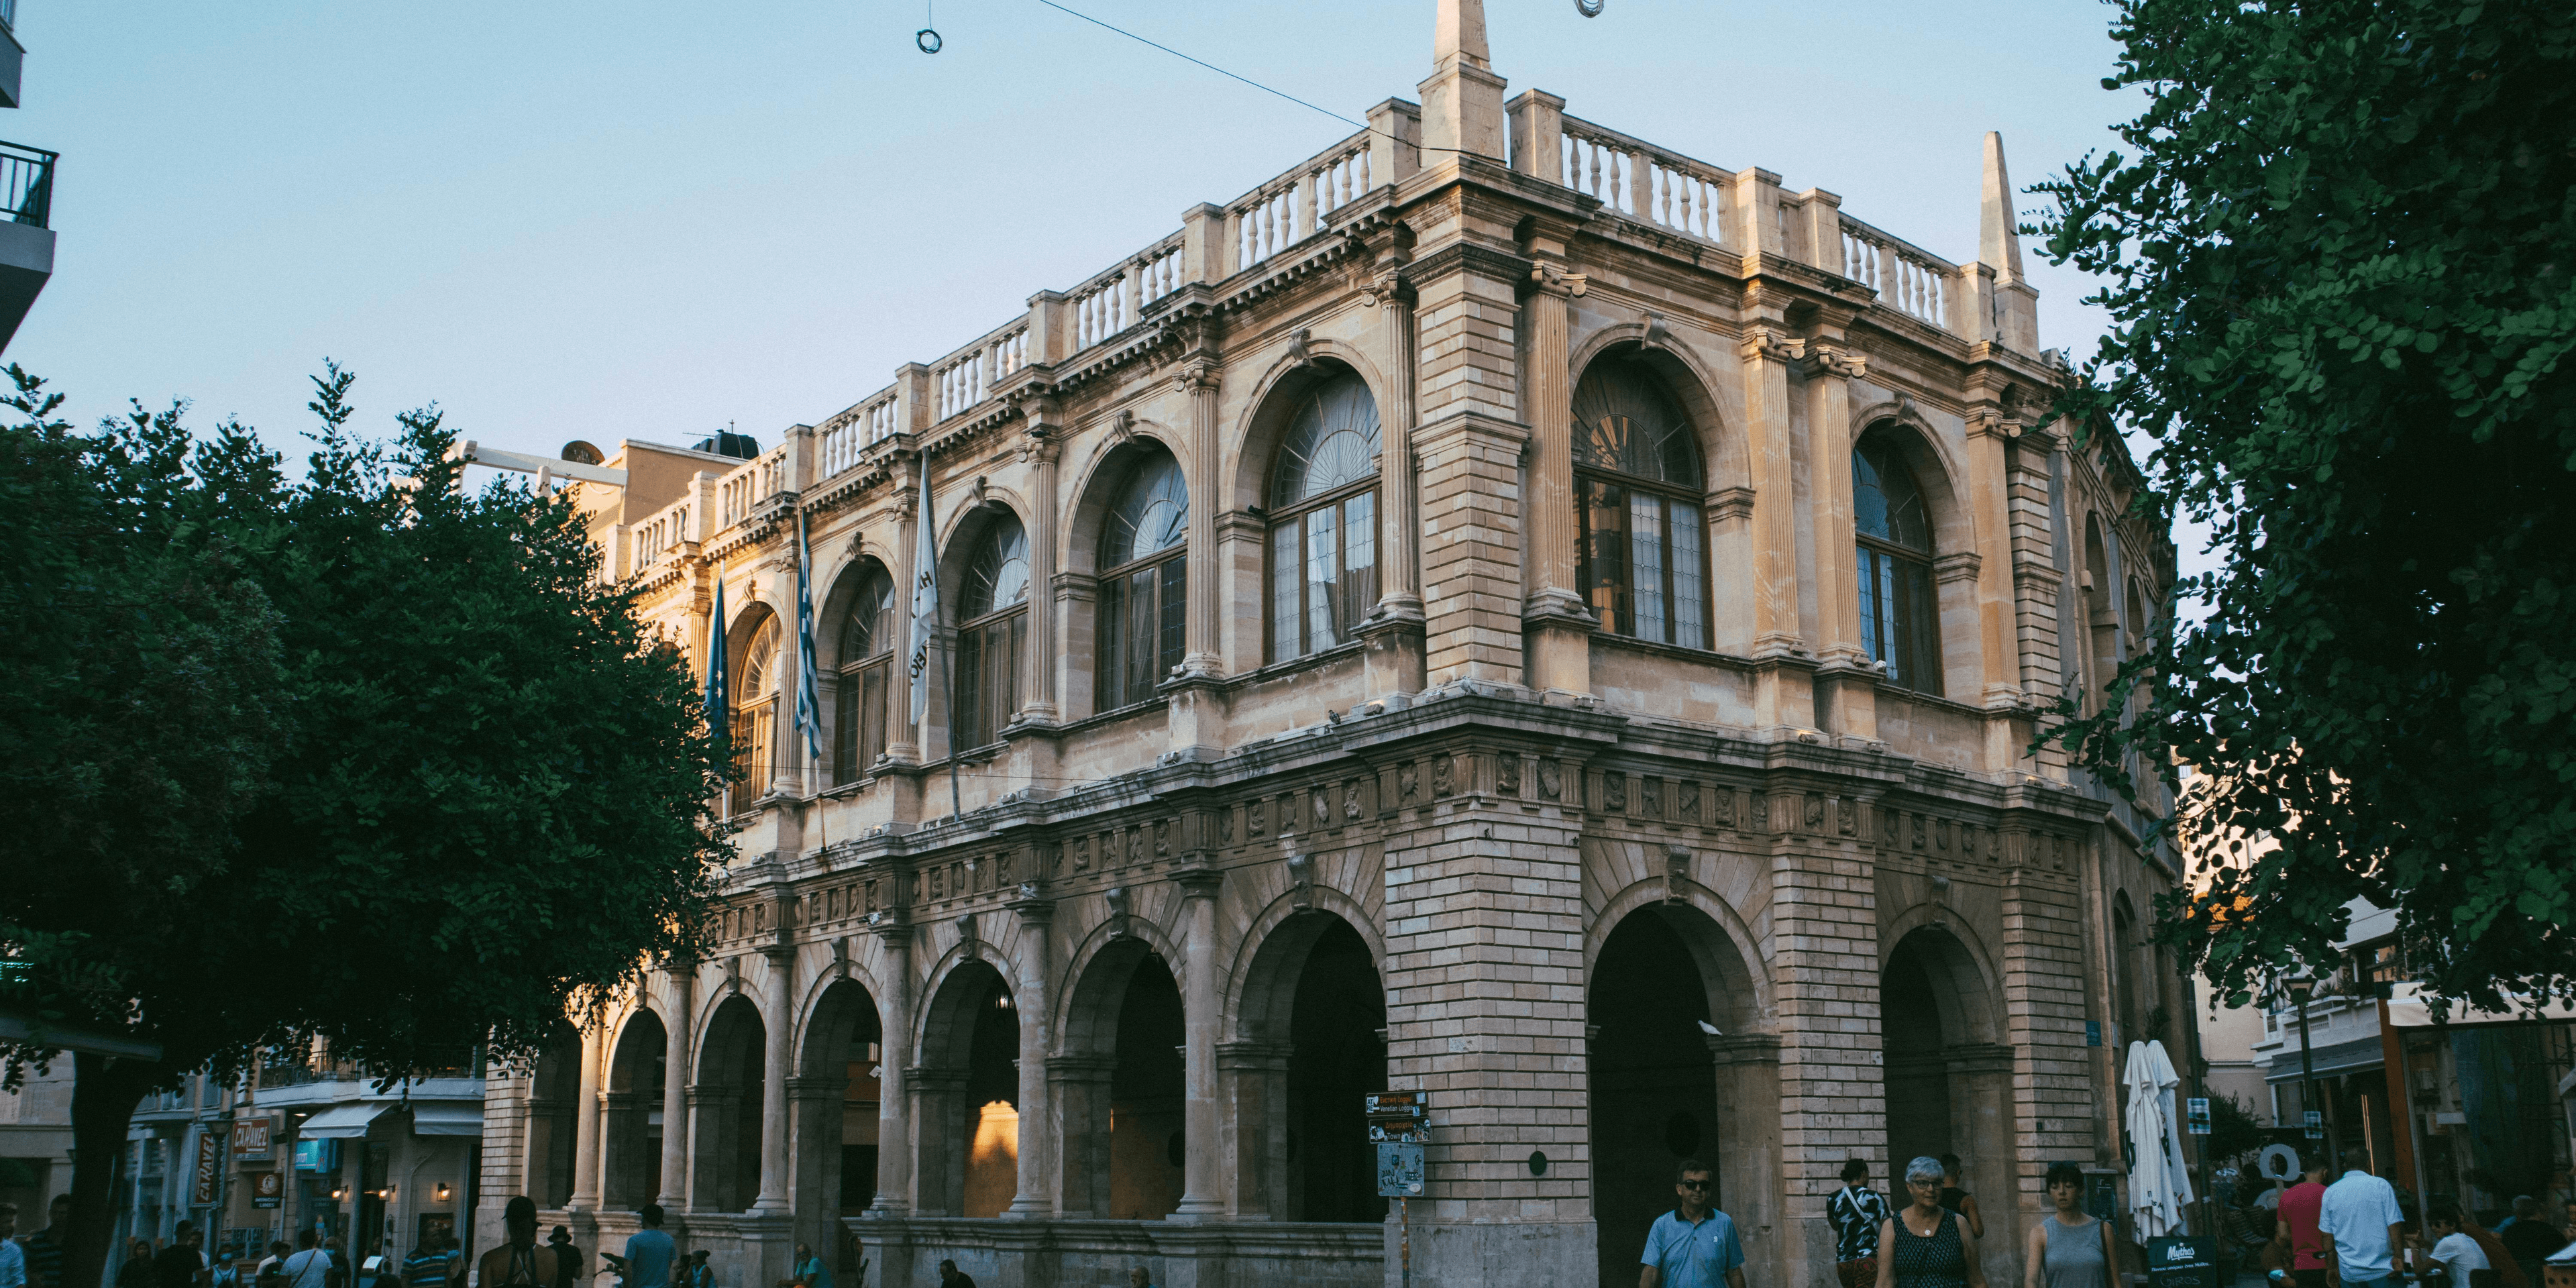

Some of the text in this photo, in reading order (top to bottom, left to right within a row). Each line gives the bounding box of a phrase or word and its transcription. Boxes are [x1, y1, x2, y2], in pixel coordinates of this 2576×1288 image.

[1399, 1104, 1413, 1112] Loggia
[234, 1121, 267, 1152] CARAVEL
[199, 1136, 213, 1201] CARAVEL
[2167, 1245, 2195, 1260] Mythos
[2160, 1273, 2200, 1287] GIROS
